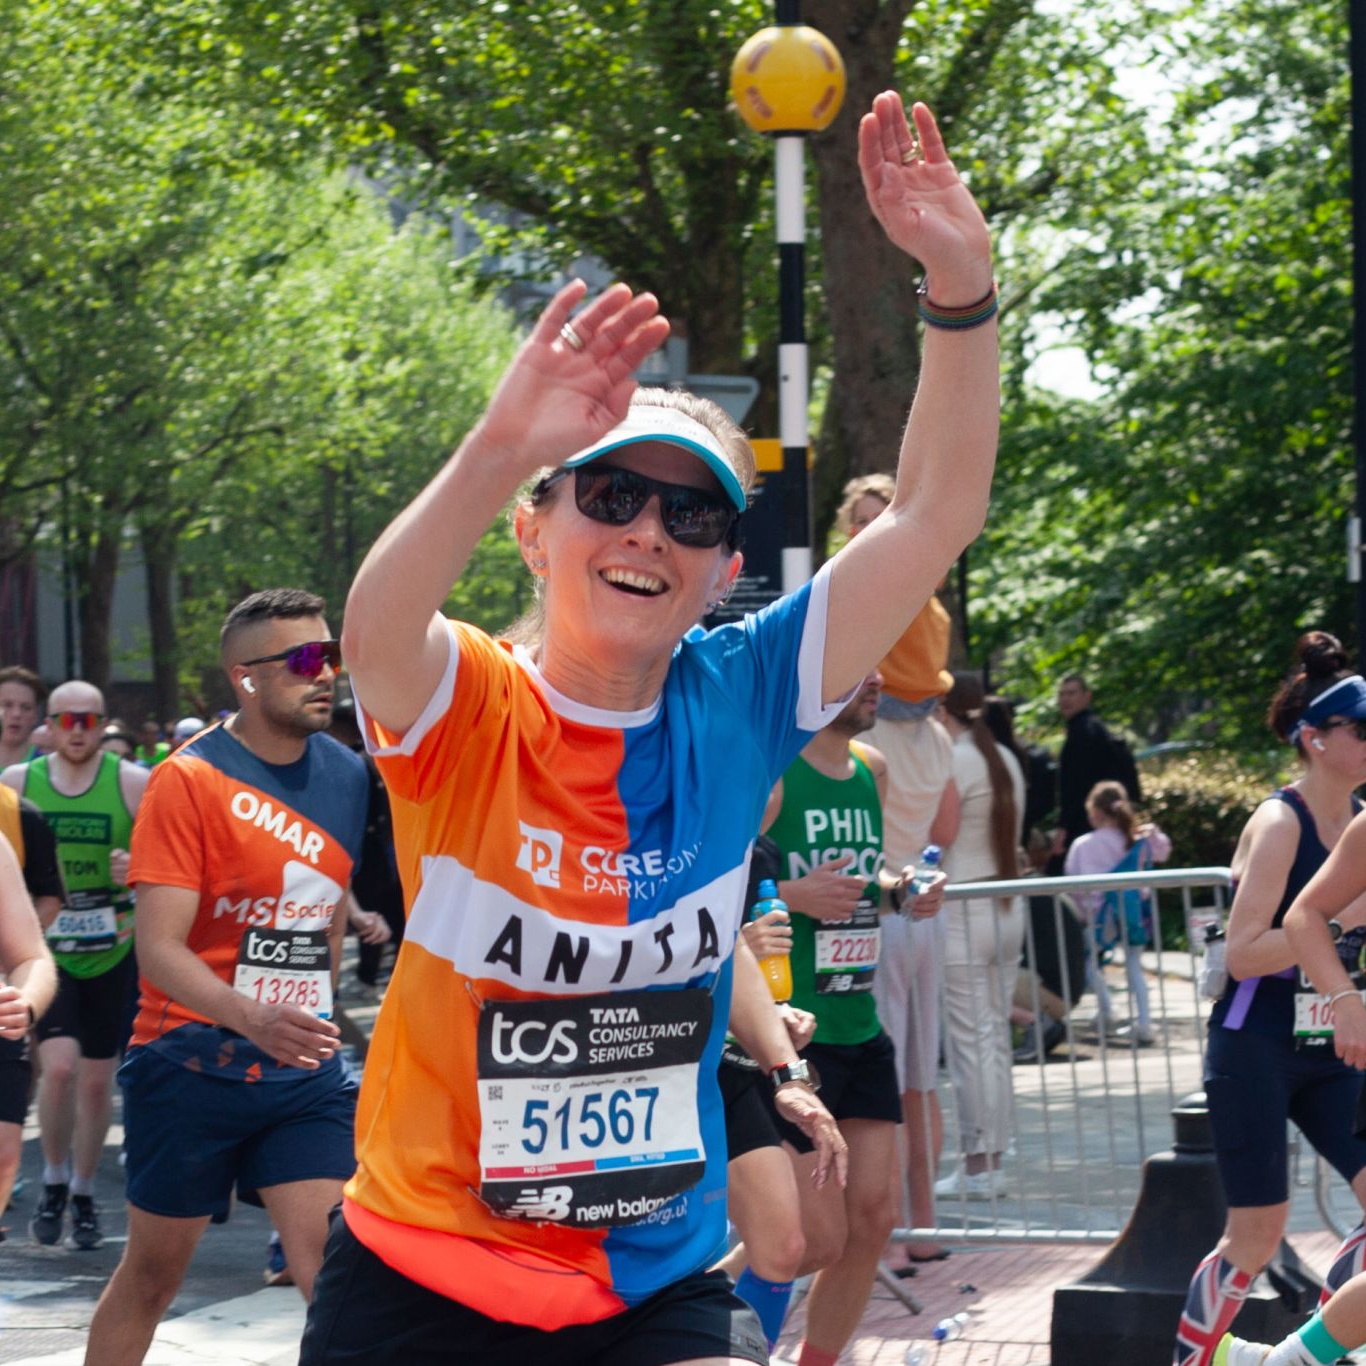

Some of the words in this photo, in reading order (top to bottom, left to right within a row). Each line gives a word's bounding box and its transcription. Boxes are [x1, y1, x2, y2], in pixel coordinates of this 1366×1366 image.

[231, 791, 325, 864] OMAR
[805, 808, 880, 844] PHIL
[64, 860, 98, 876] TOM
[580, 846, 664, 876] CURE
[213, 896, 278, 927] MS
[247, 931, 290, 963] tcs
[484, 906, 720, 984] ANITA
[252, 975, 320, 1008] 13285
[1308, 1002, 1336, 1026] 10
[491, 1011, 579, 1065] tcs
[589, 1007, 640, 1024] TATA
[588, 1020, 698, 1045] CONSULTANCY
[588, 1041, 655, 1065] SERVICES
[521, 1086, 660, 1155] 51567
[576, 1202, 614, 1222] new
[618, 1192, 681, 1218] balan
